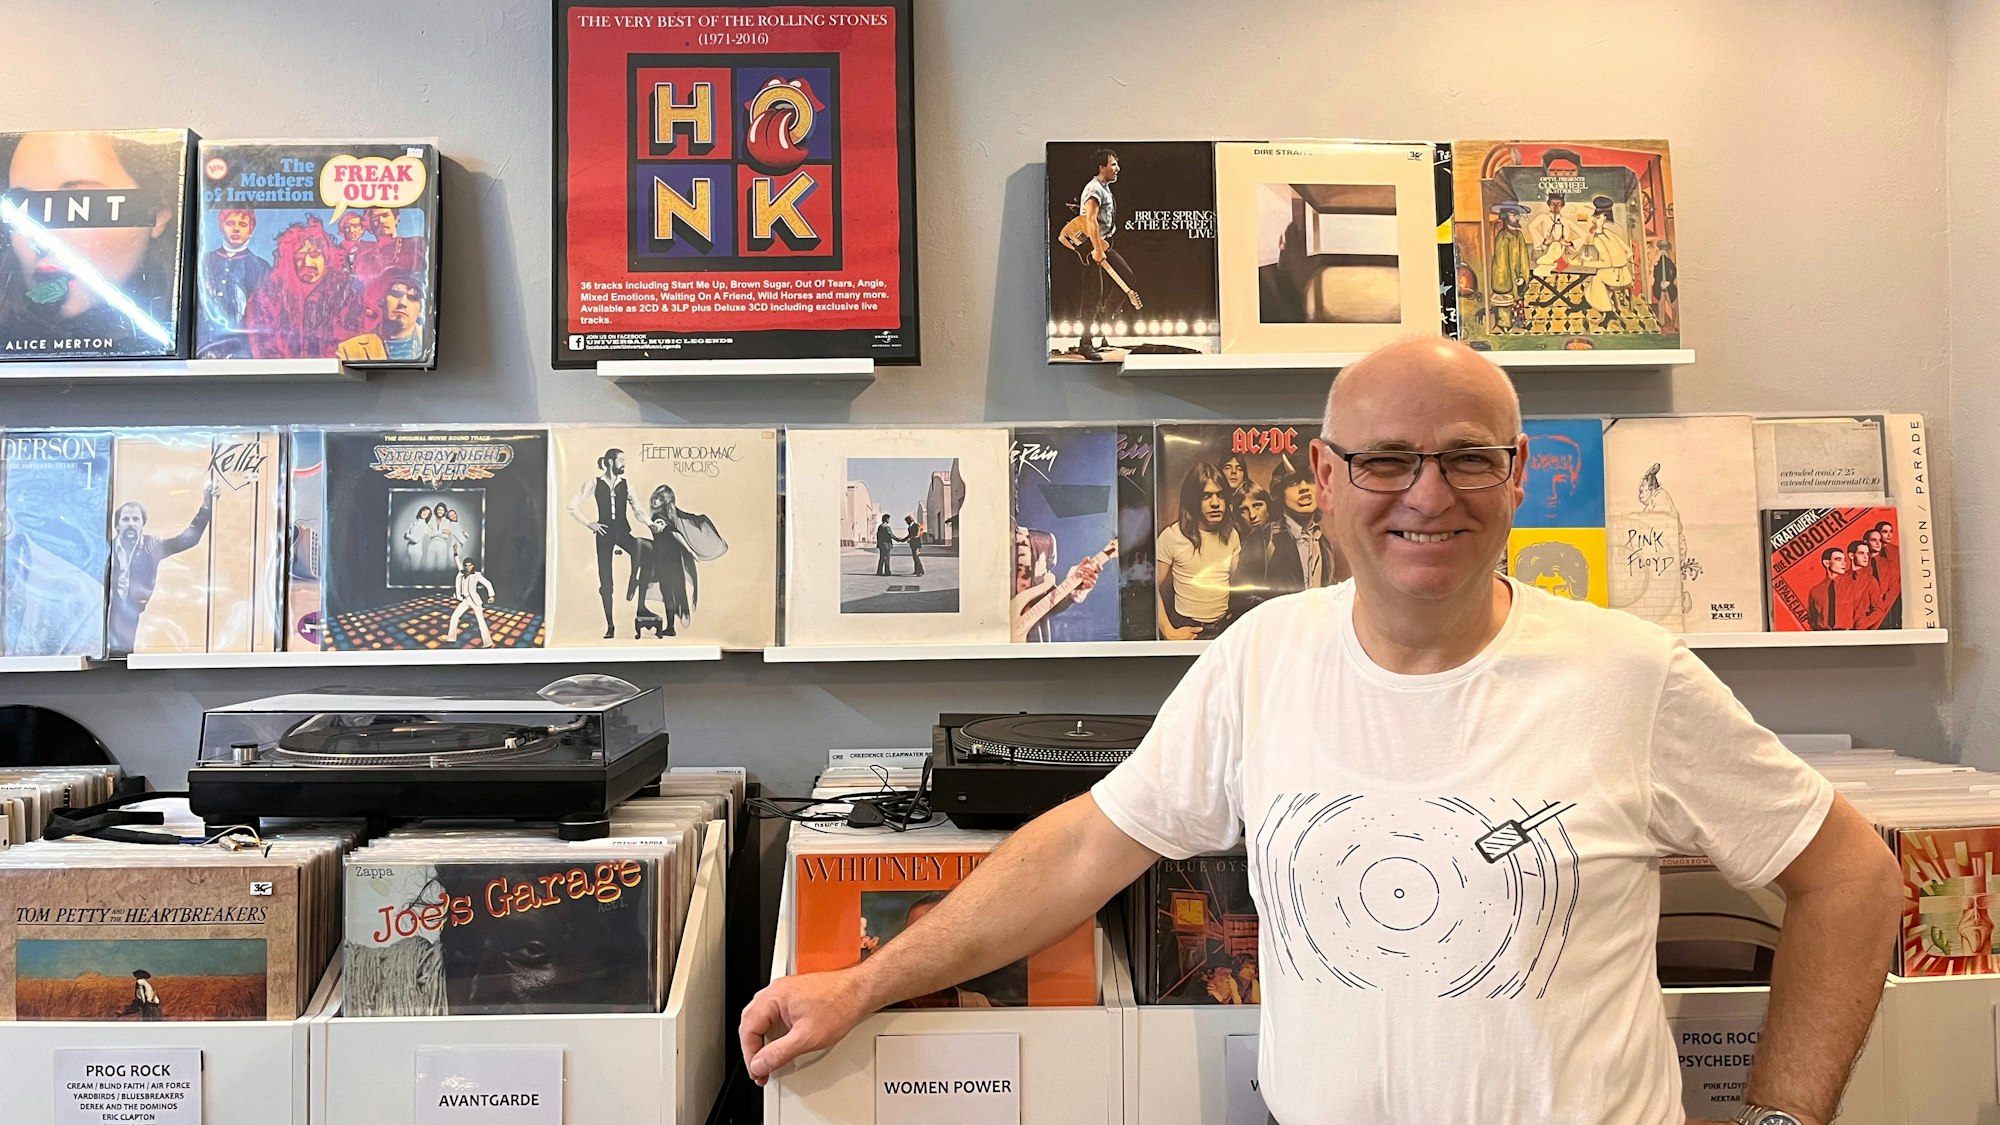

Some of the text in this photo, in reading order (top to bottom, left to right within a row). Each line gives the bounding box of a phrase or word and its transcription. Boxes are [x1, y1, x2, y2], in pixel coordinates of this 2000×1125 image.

[577, 14, 888, 28] THE VERY BEST OF THE ROLLING STONES
[698, 33, 769, 45] (1971-2016)
[280, 157, 315, 173] The
[240, 172, 314, 188] Mothers
[333, 165, 414, 182] FREAK
[1538, 181, 1588, 189] COGWHEEL
[203, 187, 315, 202] of Invention
[343, 183, 400, 201] OUT!
[1134, 210, 1171, 220] BRUCE
[1124, 220, 1135, 231] &
[1136, 220, 1160, 230] THE
[1162, 220, 1170, 230] E
[580, 279, 887, 291] 36 tracks including Start Me Up, Brown Sugar, Out Of Tears, Angie,
[580, 291, 889, 302] Mixed Emotions, Waiting On A Friend, Wild Horses and many more.
[580, 301, 878, 313] Available as 2CD & 3LP plus Deluxe 3CD including exclusive live
[580, 316, 612, 324] tracks.
[5, 338, 114, 351] ALICE MERTON
[370, 444, 514, 466] SATURDAY NIGHT
[1910, 421, 1924, 495] PARADE
[411, 463, 469, 476] FEVER
[673, 461, 720, 477] RUMOURS
[1780, 469, 1813, 477] extended
[1780, 478, 1814, 487] extended
[1815, 478, 1861, 486] instrumental
[1770, 509, 1821, 550] KRAFTWERK
[1625, 527, 1664, 553] PINK
[1773, 510, 1849, 573] DIE ROBOTER
[1627, 548, 1675, 576] FLOYD
[1711, 603, 1735, 611] RARE
[1711, 612, 1743, 620] EARTH
[355, 866, 395, 880] Zappa
[802, 855, 948, 883] WHITNEY
[1165, 860, 1208, 873] BLUE
[373, 859, 642, 943] Joe's Garage
[16, 907, 51, 923] TOM
[55, 907, 111, 923] PETTY
[124, 906, 268, 923] HEARTBREAKERS
[1682, 1033, 1722, 1045] PROG
[86, 1064, 171, 1077] PROG ROCK
[66, 1082, 93, 1090] CREAM
[165, 1081, 191, 1089] FORCE
[884, 1080, 1012, 1094] WOMEN POWER
[1703, 1082, 1721, 1090] PINK
[121, 1092, 185, 1100] BLUESBREAKERS
[439, 1093, 540, 1107] AVANTGARDE
